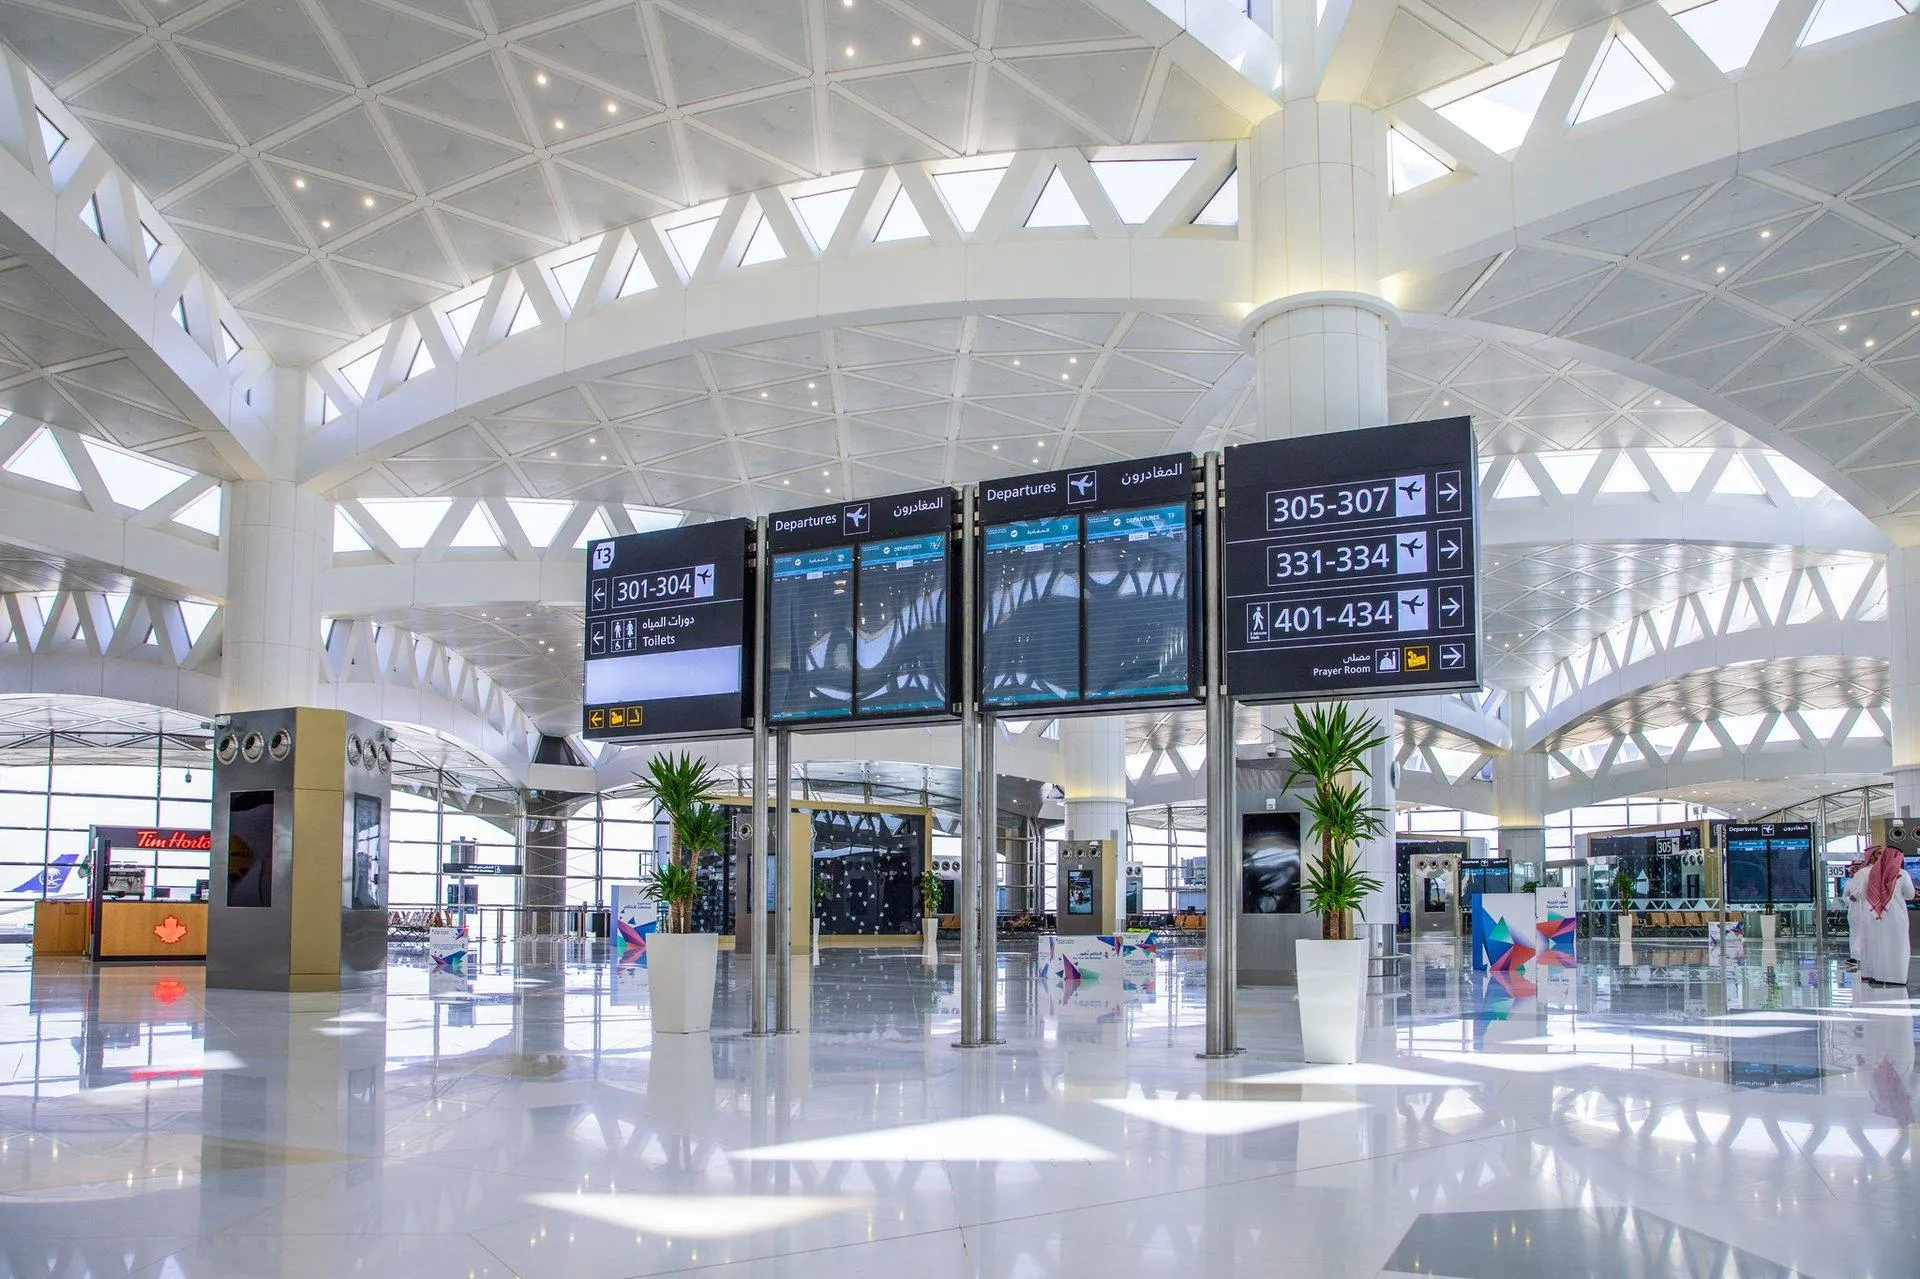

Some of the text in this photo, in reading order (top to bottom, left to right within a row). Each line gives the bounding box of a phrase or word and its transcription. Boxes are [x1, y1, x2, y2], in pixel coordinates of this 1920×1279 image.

[1121, 463, 1183, 485] المغادرون
[987, 482, 1057, 501] Departures
[893, 497, 943, 517] المغادرون
[1274, 487, 1389, 522] 305-307
[775, 513, 837, 532] Departures
[1126, 514, 1160, 524] DEPARTURES
[596, 547, 611, 564] T3
[894, 543, 922, 552] DEPARTURES
[1276, 543, 1390, 577] 331-334
[617, 573, 691, 602] 301-304
[642, 615, 695, 631] دورات المياه
[1274, 600, 1393, 632] 401-434
[642, 635, 676, 647] Toilets
[1342, 653, 1371, 664] مصلى
[1313, 665, 1371, 678] Prayer Room
[137, 831, 166, 847] Tim
[1658, 841, 1672, 853] 305
[1828, 866, 1844, 876] 305
